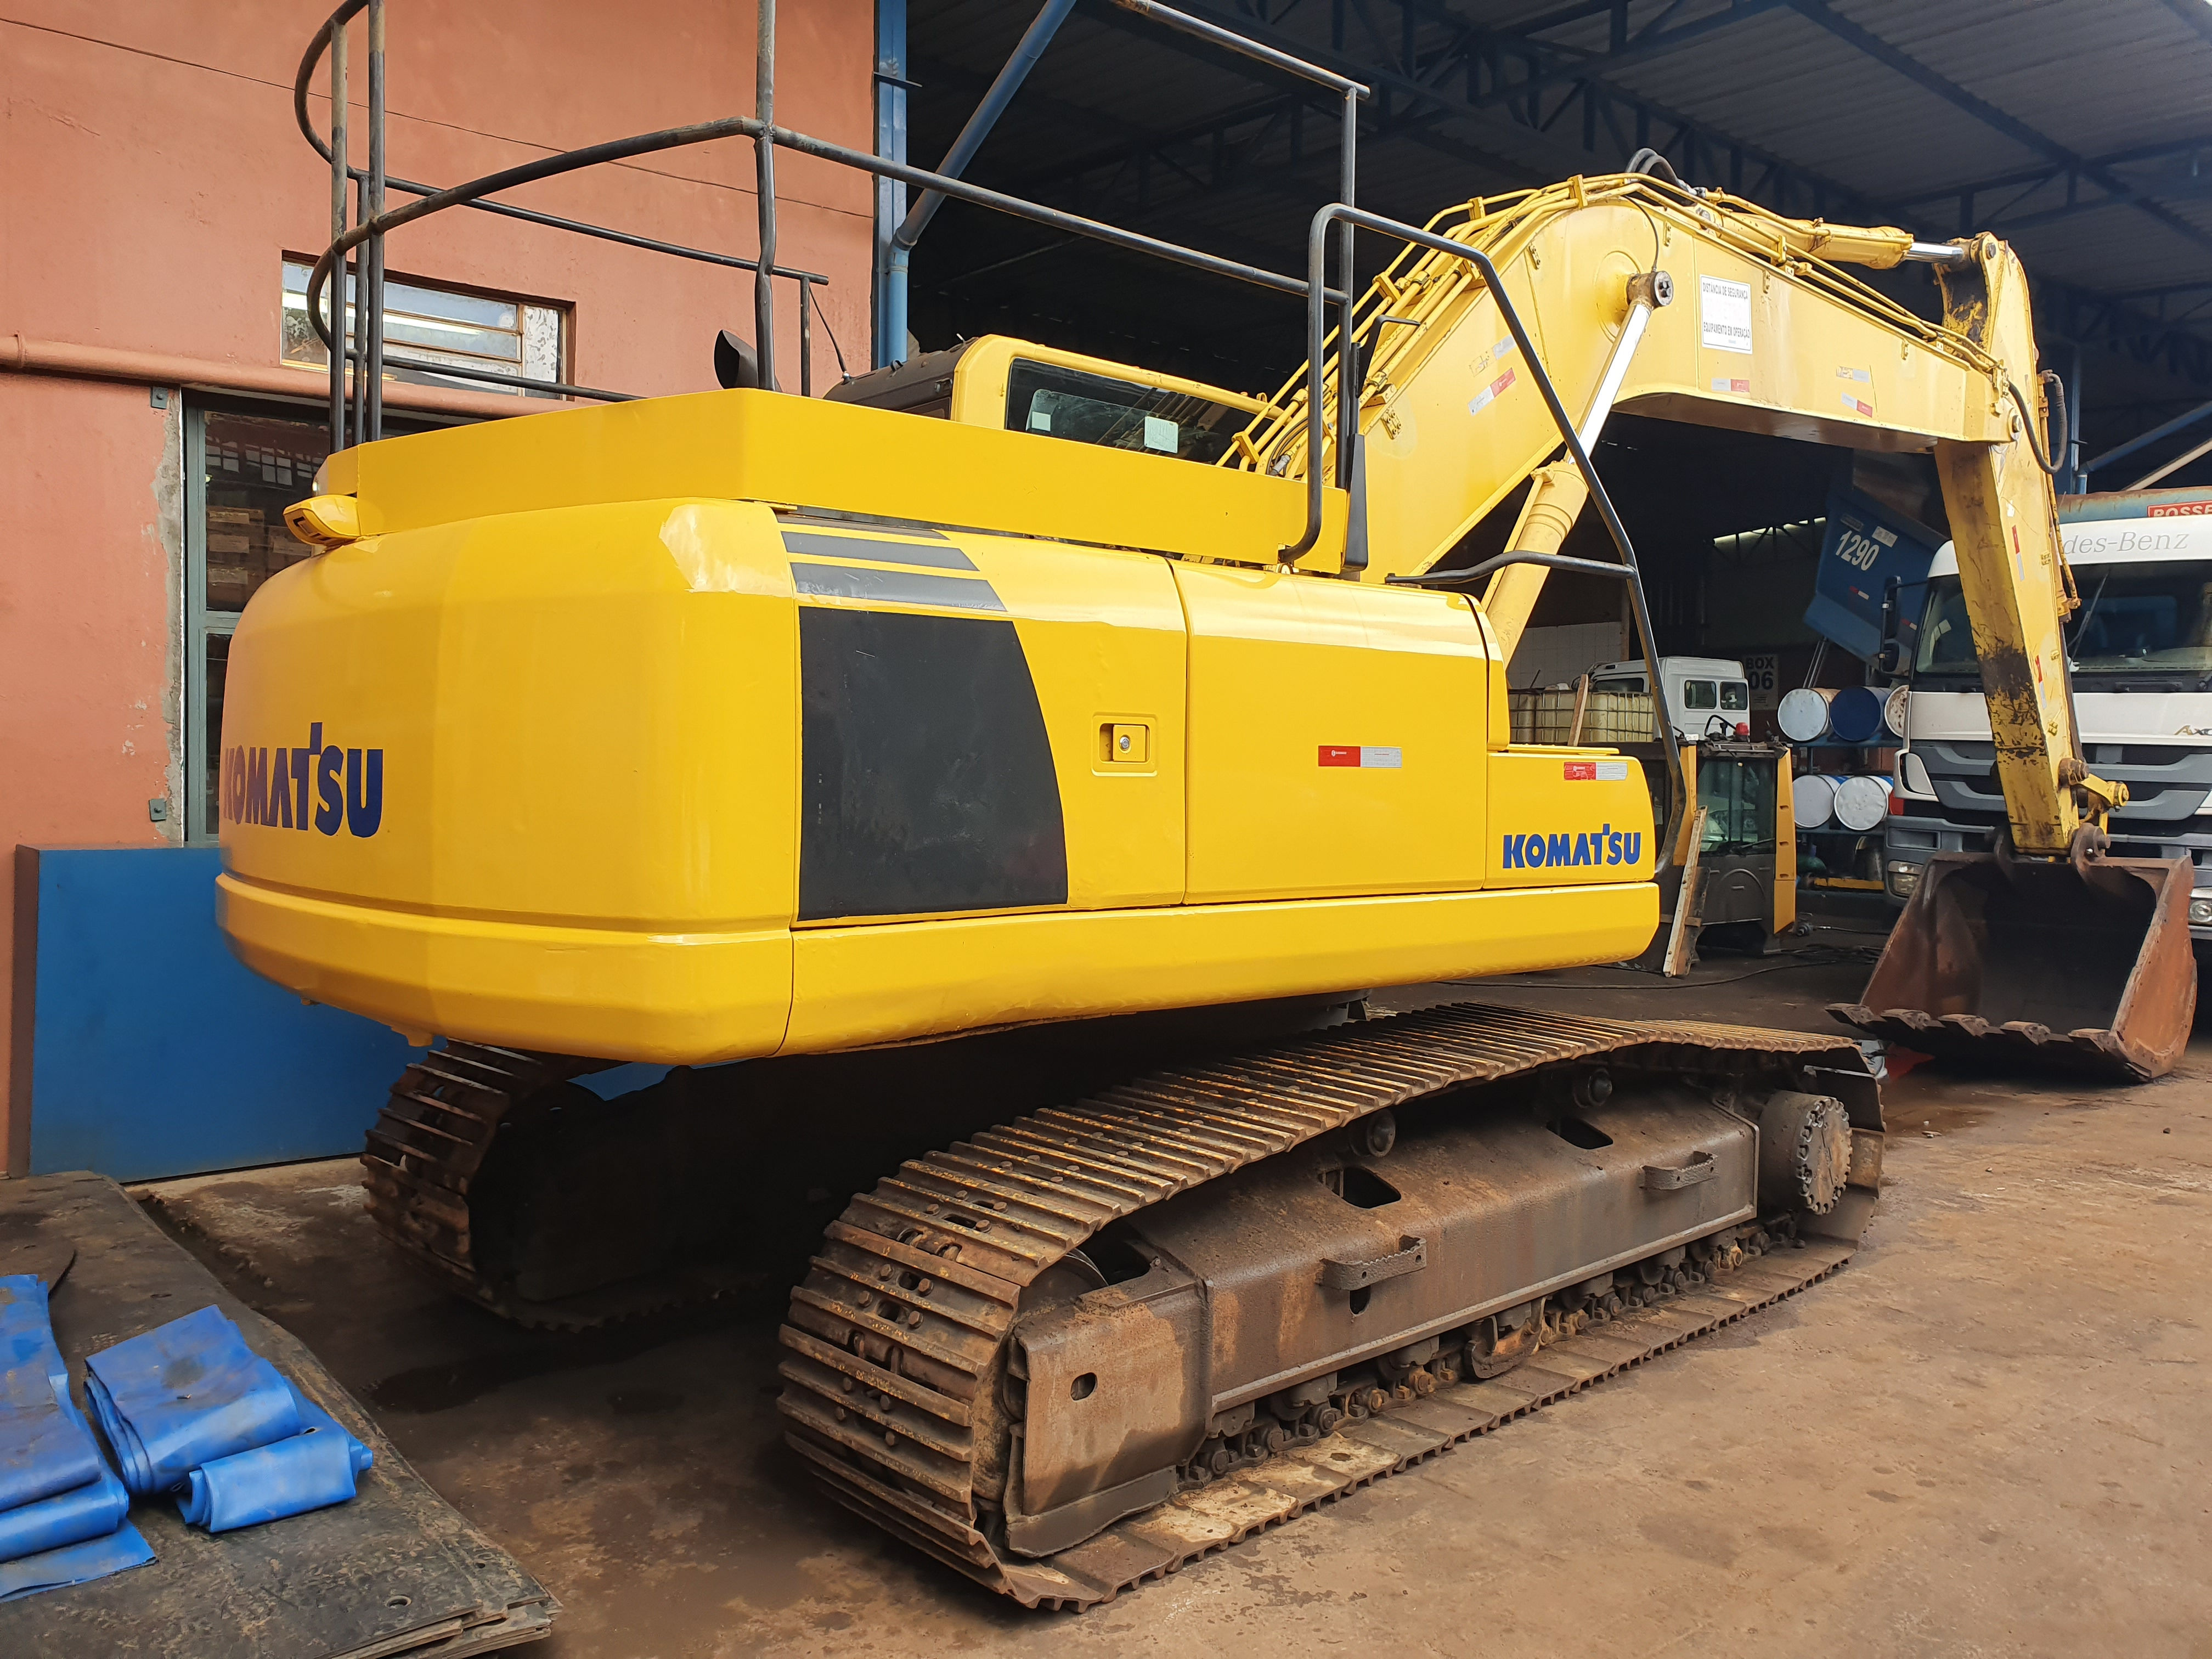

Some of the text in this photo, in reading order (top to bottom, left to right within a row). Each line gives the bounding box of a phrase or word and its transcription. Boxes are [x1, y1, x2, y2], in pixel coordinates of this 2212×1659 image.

[1723, 286, 1727, 296] DE
[1728, 286, 1748, 301] SEGURANÇA
[1703, 321, 1750, 340] EQUIPAMENTO EM OPERAÇÃO
[1836, 530, 1880, 571] 1290
[1746, 657, 1774, 669] BOX
[1749, 671, 1774, 690] 06
[223, 722, 383, 838] KOMATSU
[1503, 823, 1641, 868] KOMATSU
